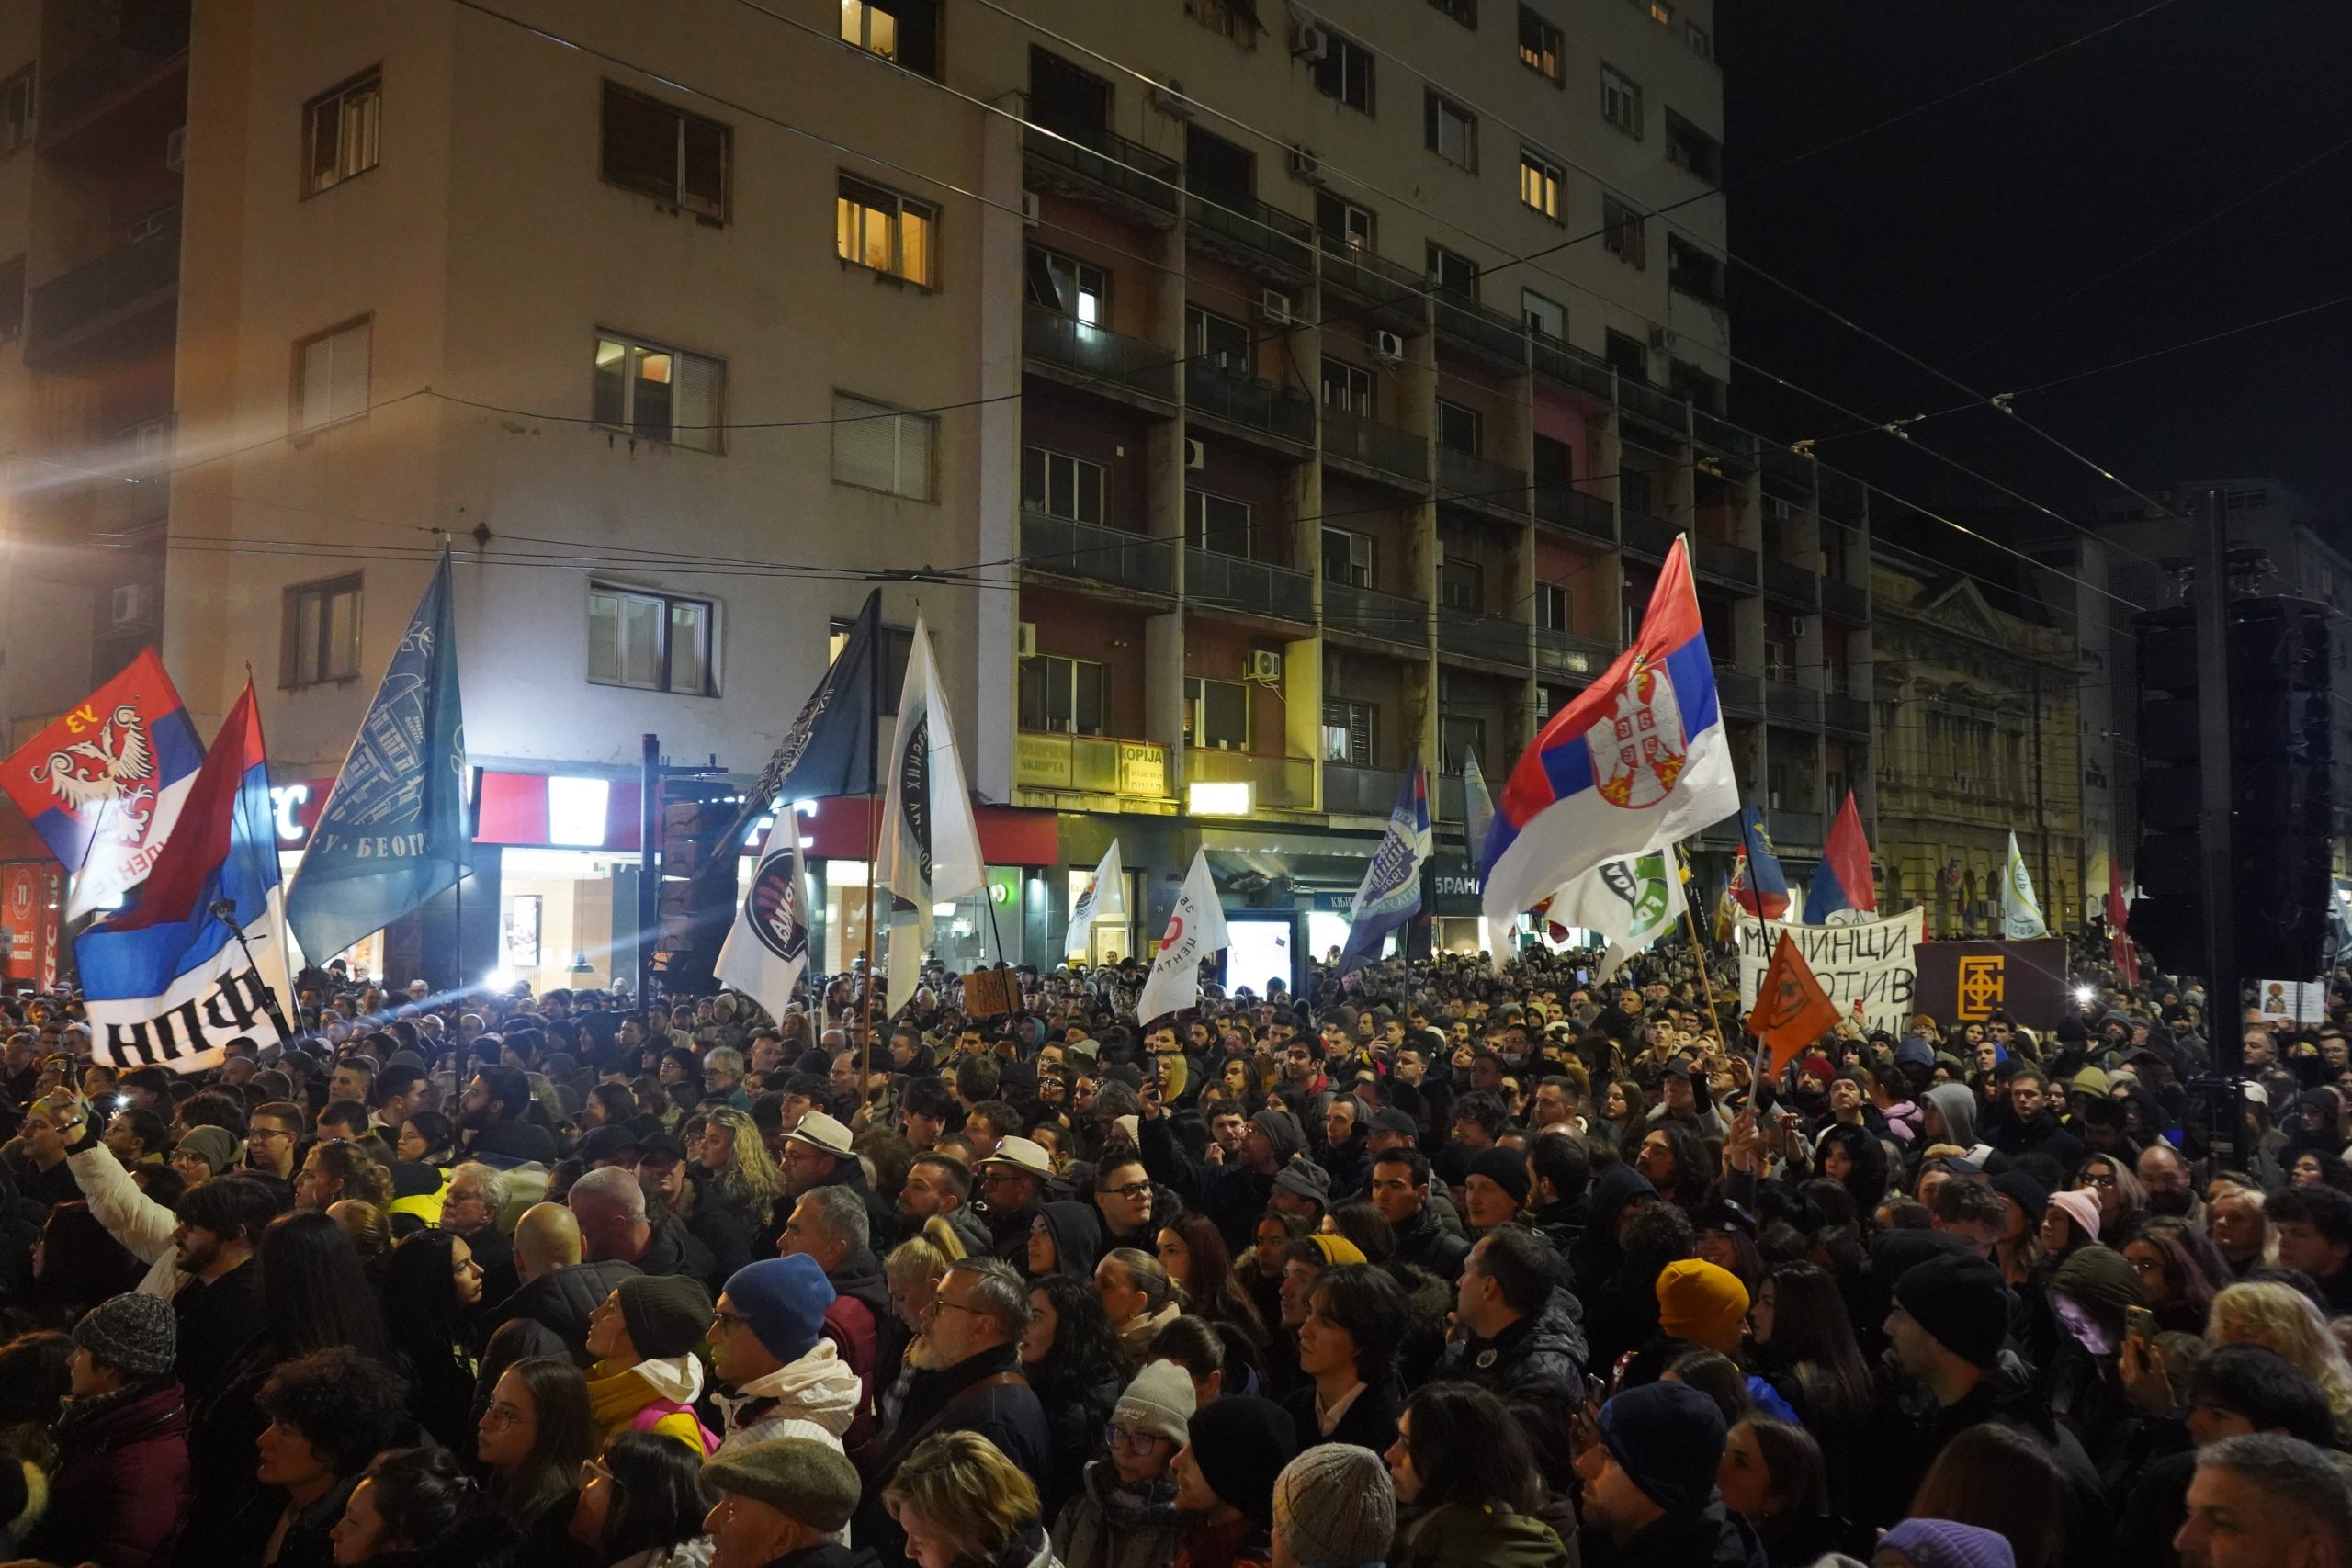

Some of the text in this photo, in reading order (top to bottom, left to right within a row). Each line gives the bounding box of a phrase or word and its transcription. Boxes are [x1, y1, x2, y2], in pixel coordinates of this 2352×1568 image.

[356, 832, 426, 858] БЕОГР
[1330, 896, 1353, 908] КЊИ
[12, 931, 30, 944] aruči
[44, 924, 58, 996] KFC
[1756, 967, 1915, 1004] ПОТИВ
